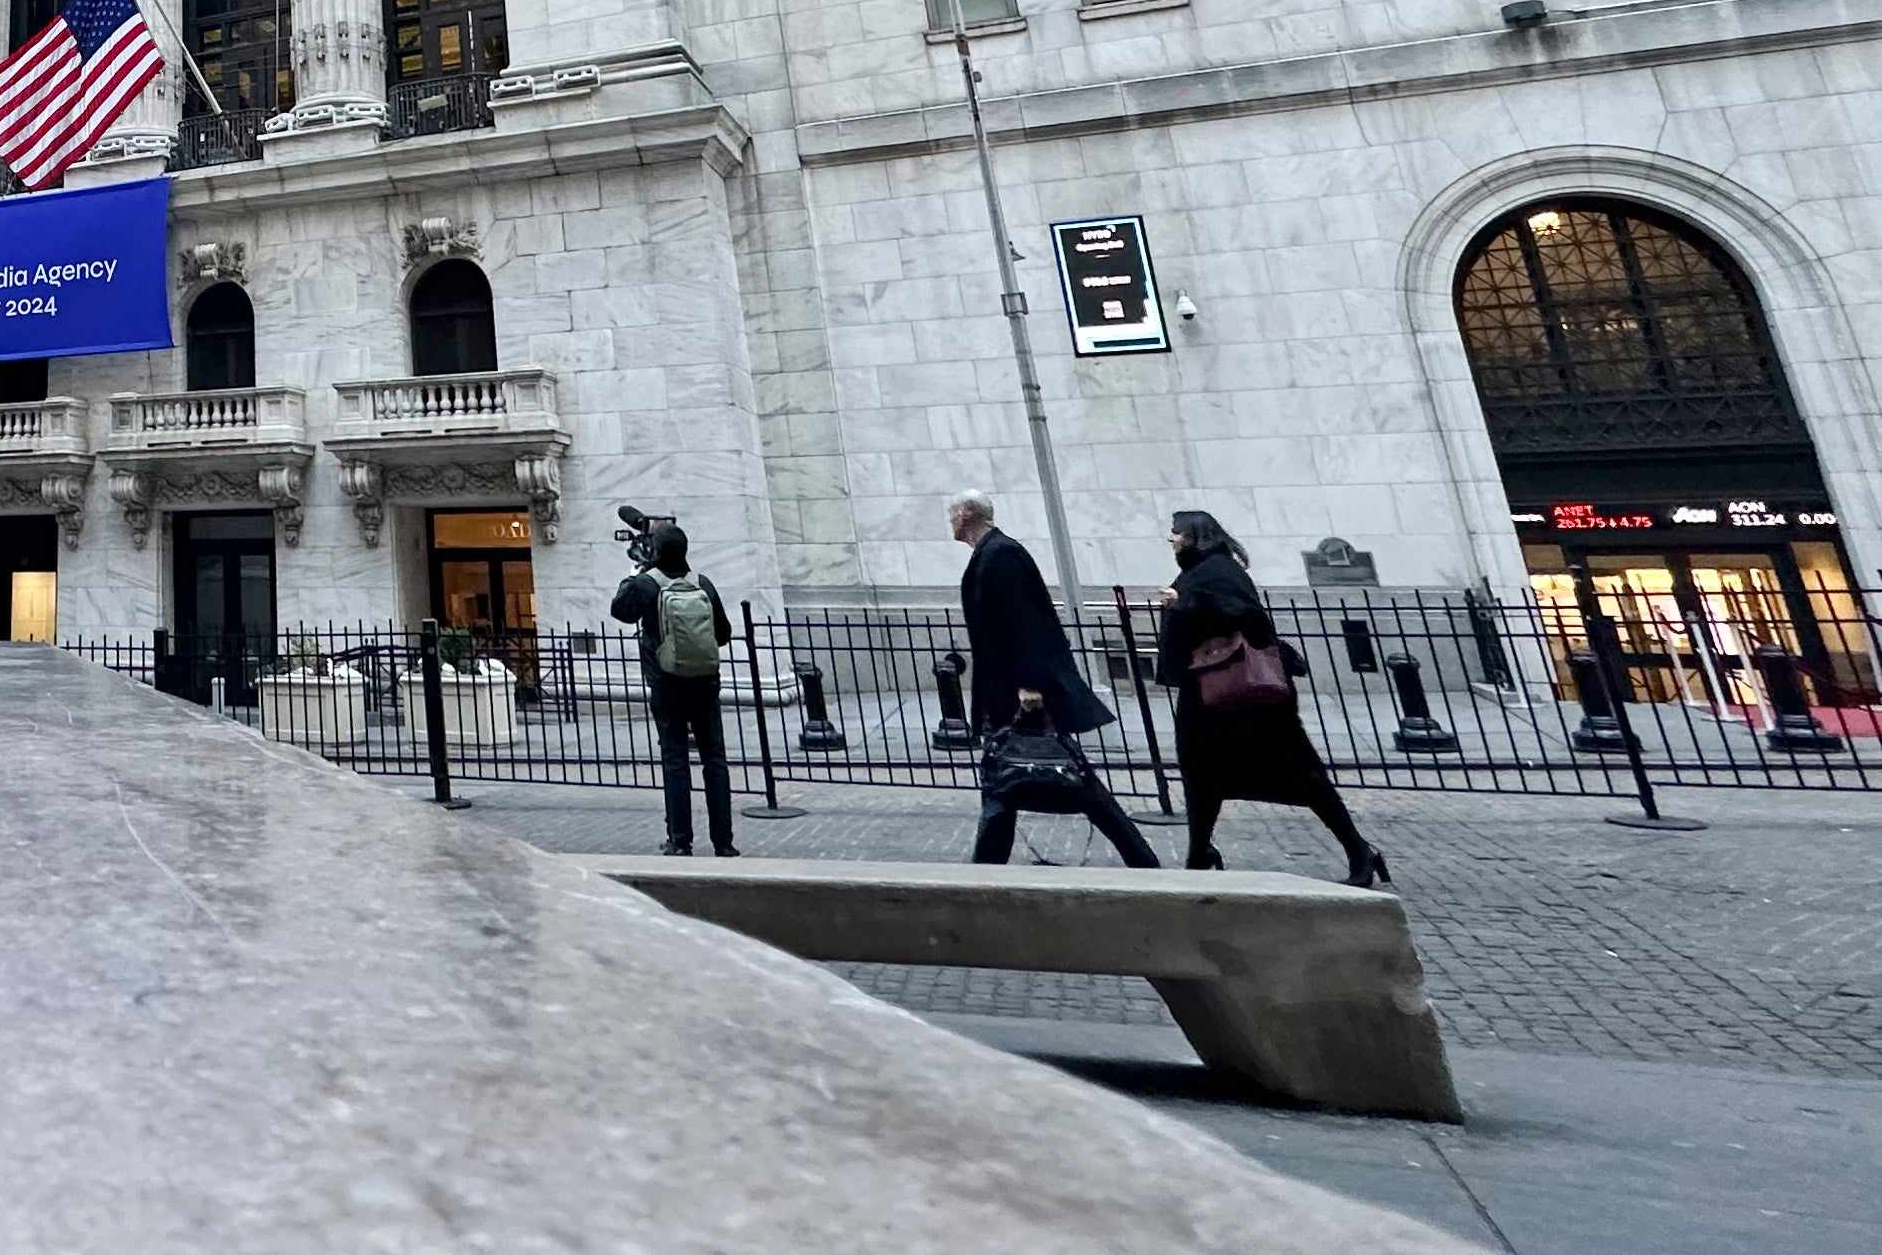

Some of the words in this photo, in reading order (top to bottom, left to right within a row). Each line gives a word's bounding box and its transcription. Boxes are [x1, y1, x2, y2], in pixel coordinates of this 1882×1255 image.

[32, 258, 118, 288] Agency
[5, 295, 58, 317] 2024
[1728, 501, 1766, 513] AON
[1730, 513, 1788, 526] 311.24
[1798, 513, 1837, 525] 0.00
